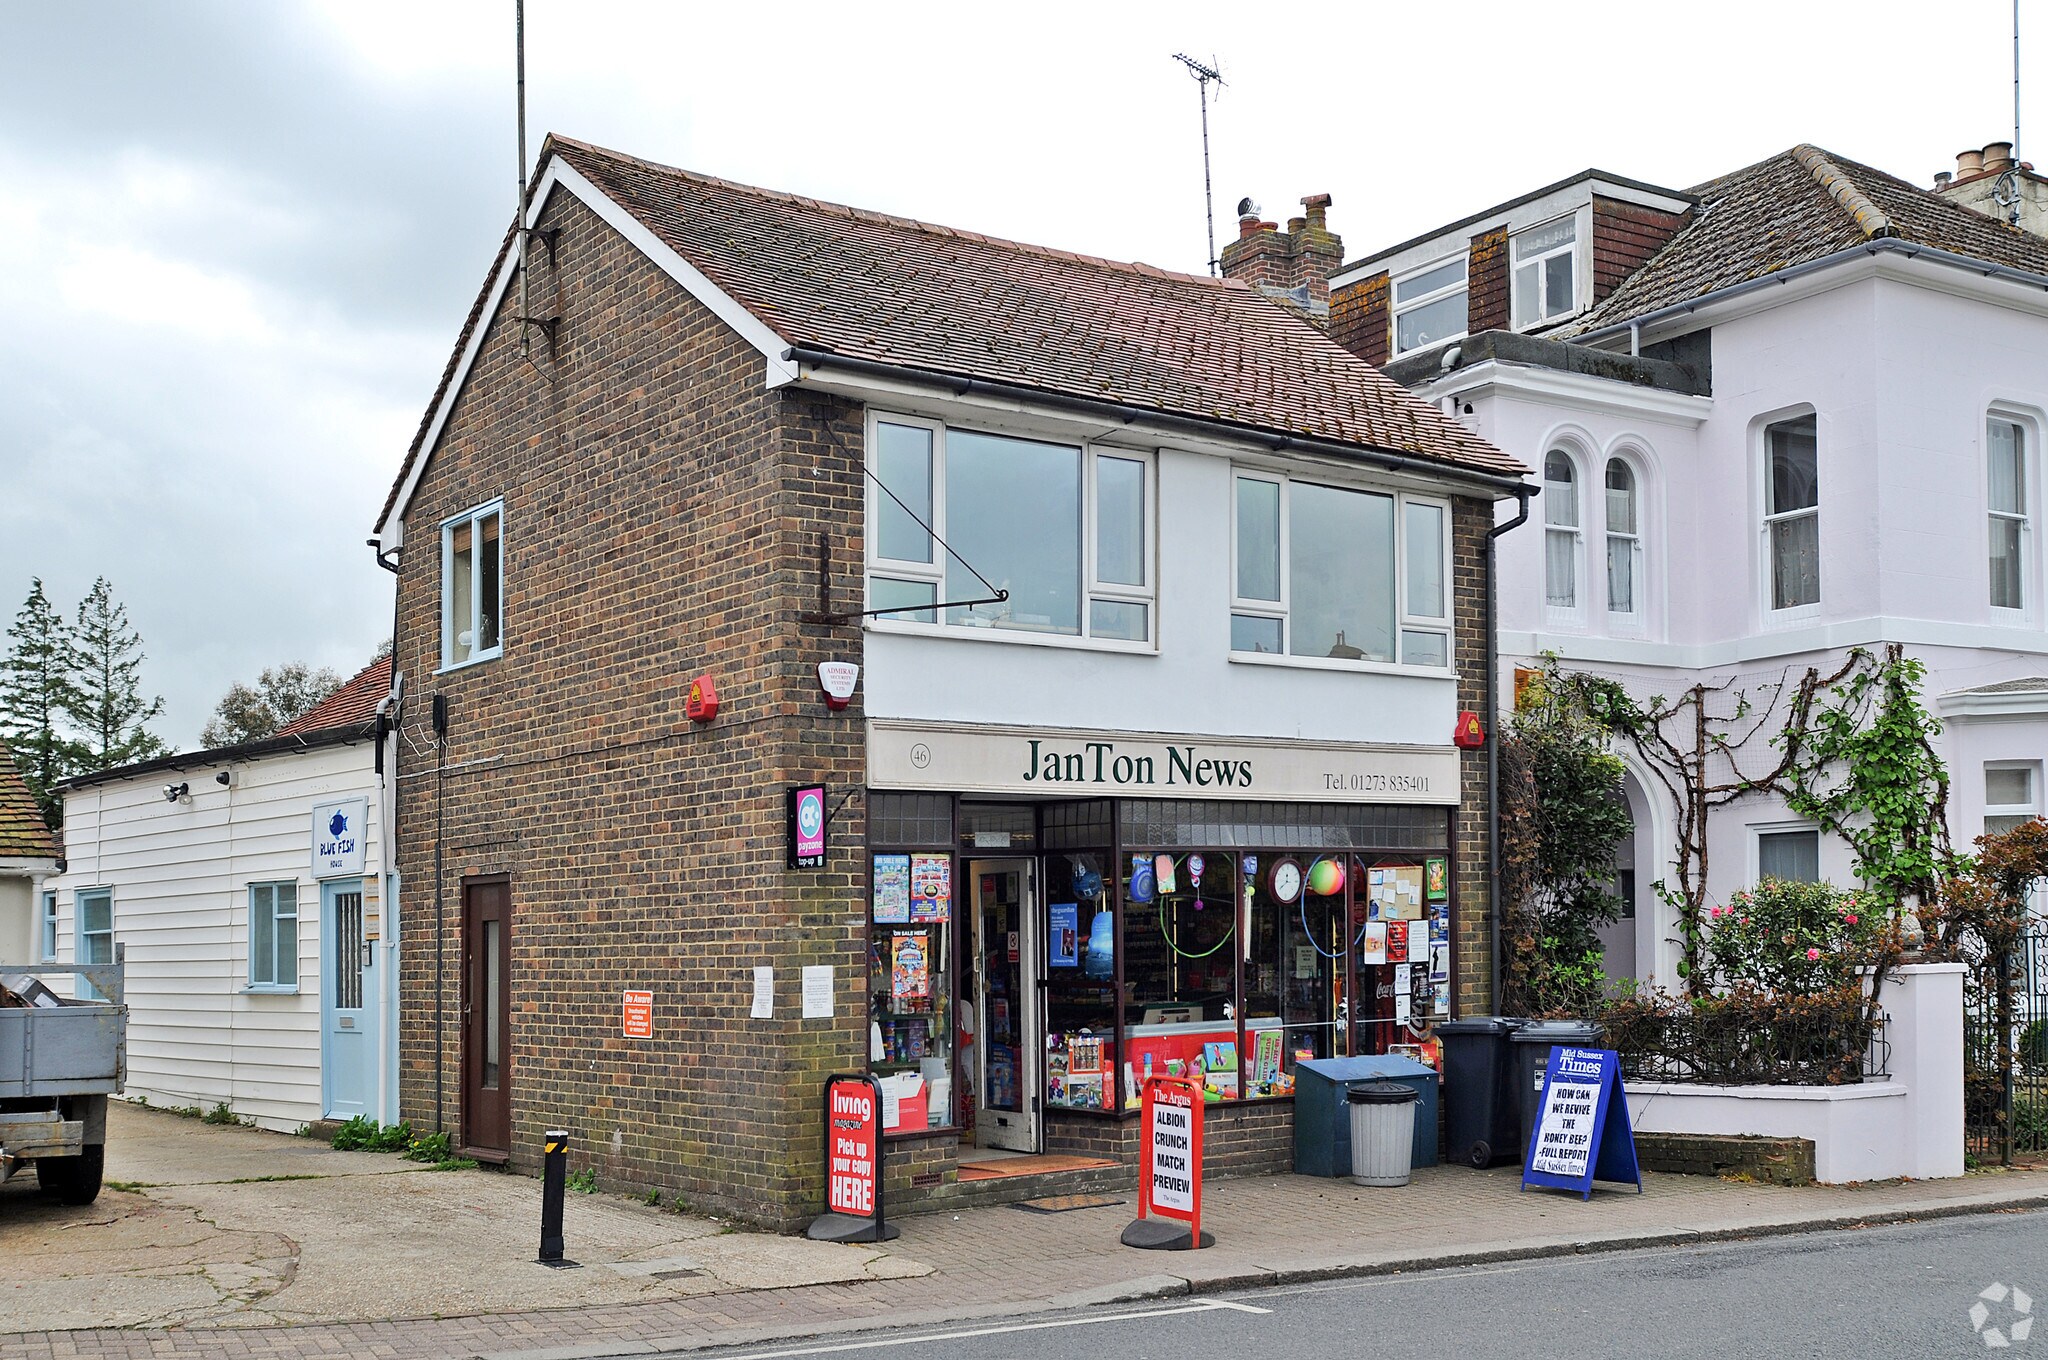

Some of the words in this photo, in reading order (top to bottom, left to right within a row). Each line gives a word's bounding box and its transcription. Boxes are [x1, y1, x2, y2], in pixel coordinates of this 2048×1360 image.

[914, 751, 926, 762] 46
[1023, 740, 1154, 784] JanTon
[1166, 746, 1252, 787] News
[1323, 774, 1347, 790] Tel.
[1351, 774, 1386, 791] 01273
[1389, 776, 1429, 792] 835401
[320, 842, 336, 856] BLUE
[338, 839, 354, 854] FISH
[798, 840, 823, 855] payzone
[330, 860, 342, 868] HOUSE
[798, 857, 814, 868] top-up
[626, 994, 633, 1003] Be
[633, 995, 651, 1004] Aware
[1561, 1049, 1576, 1057] Mid
[1577, 1050, 1603, 1060] Sussex
[1559, 1057, 1601, 1074] Times
[1154, 1089, 1167, 1103] The
[1168, 1092, 1191, 1107] Argus
[1556, 1088, 1574, 1099] HOW
[1576, 1090, 1591, 1100] CAN
[834, 1090, 871, 1122] living
[1552, 1104, 1564, 1113] WE
[1565, 1104, 1591, 1115] REVIVE
[834, 1119, 862, 1132] magazine
[1157, 1111, 1185, 1128] ALBION
[1562, 1119, 1575, 1129] THE
[1155, 1132, 1187, 1150] CRUNCH
[1544, 1133, 1568, 1143] HONEY
[1569, 1134, 1587, 1145] BEE?
[838, 1138, 855, 1156] Pick
[857, 1142, 867, 1158] up
[1559, 1149, 1587, 1161] REPORT
[833, 1157, 850, 1172] your
[852, 1161, 871, 1177] copy
[1157, 1153, 1185, 1171] MATCH
[1535, 1159, 1546, 1168] Mid
[1547, 1161, 1567, 1172] Sussex
[1568, 1163, 1584, 1174] Times
[1154, 1174, 1190, 1193] PREVIEW
[832, 1175, 872, 1211] HERE
